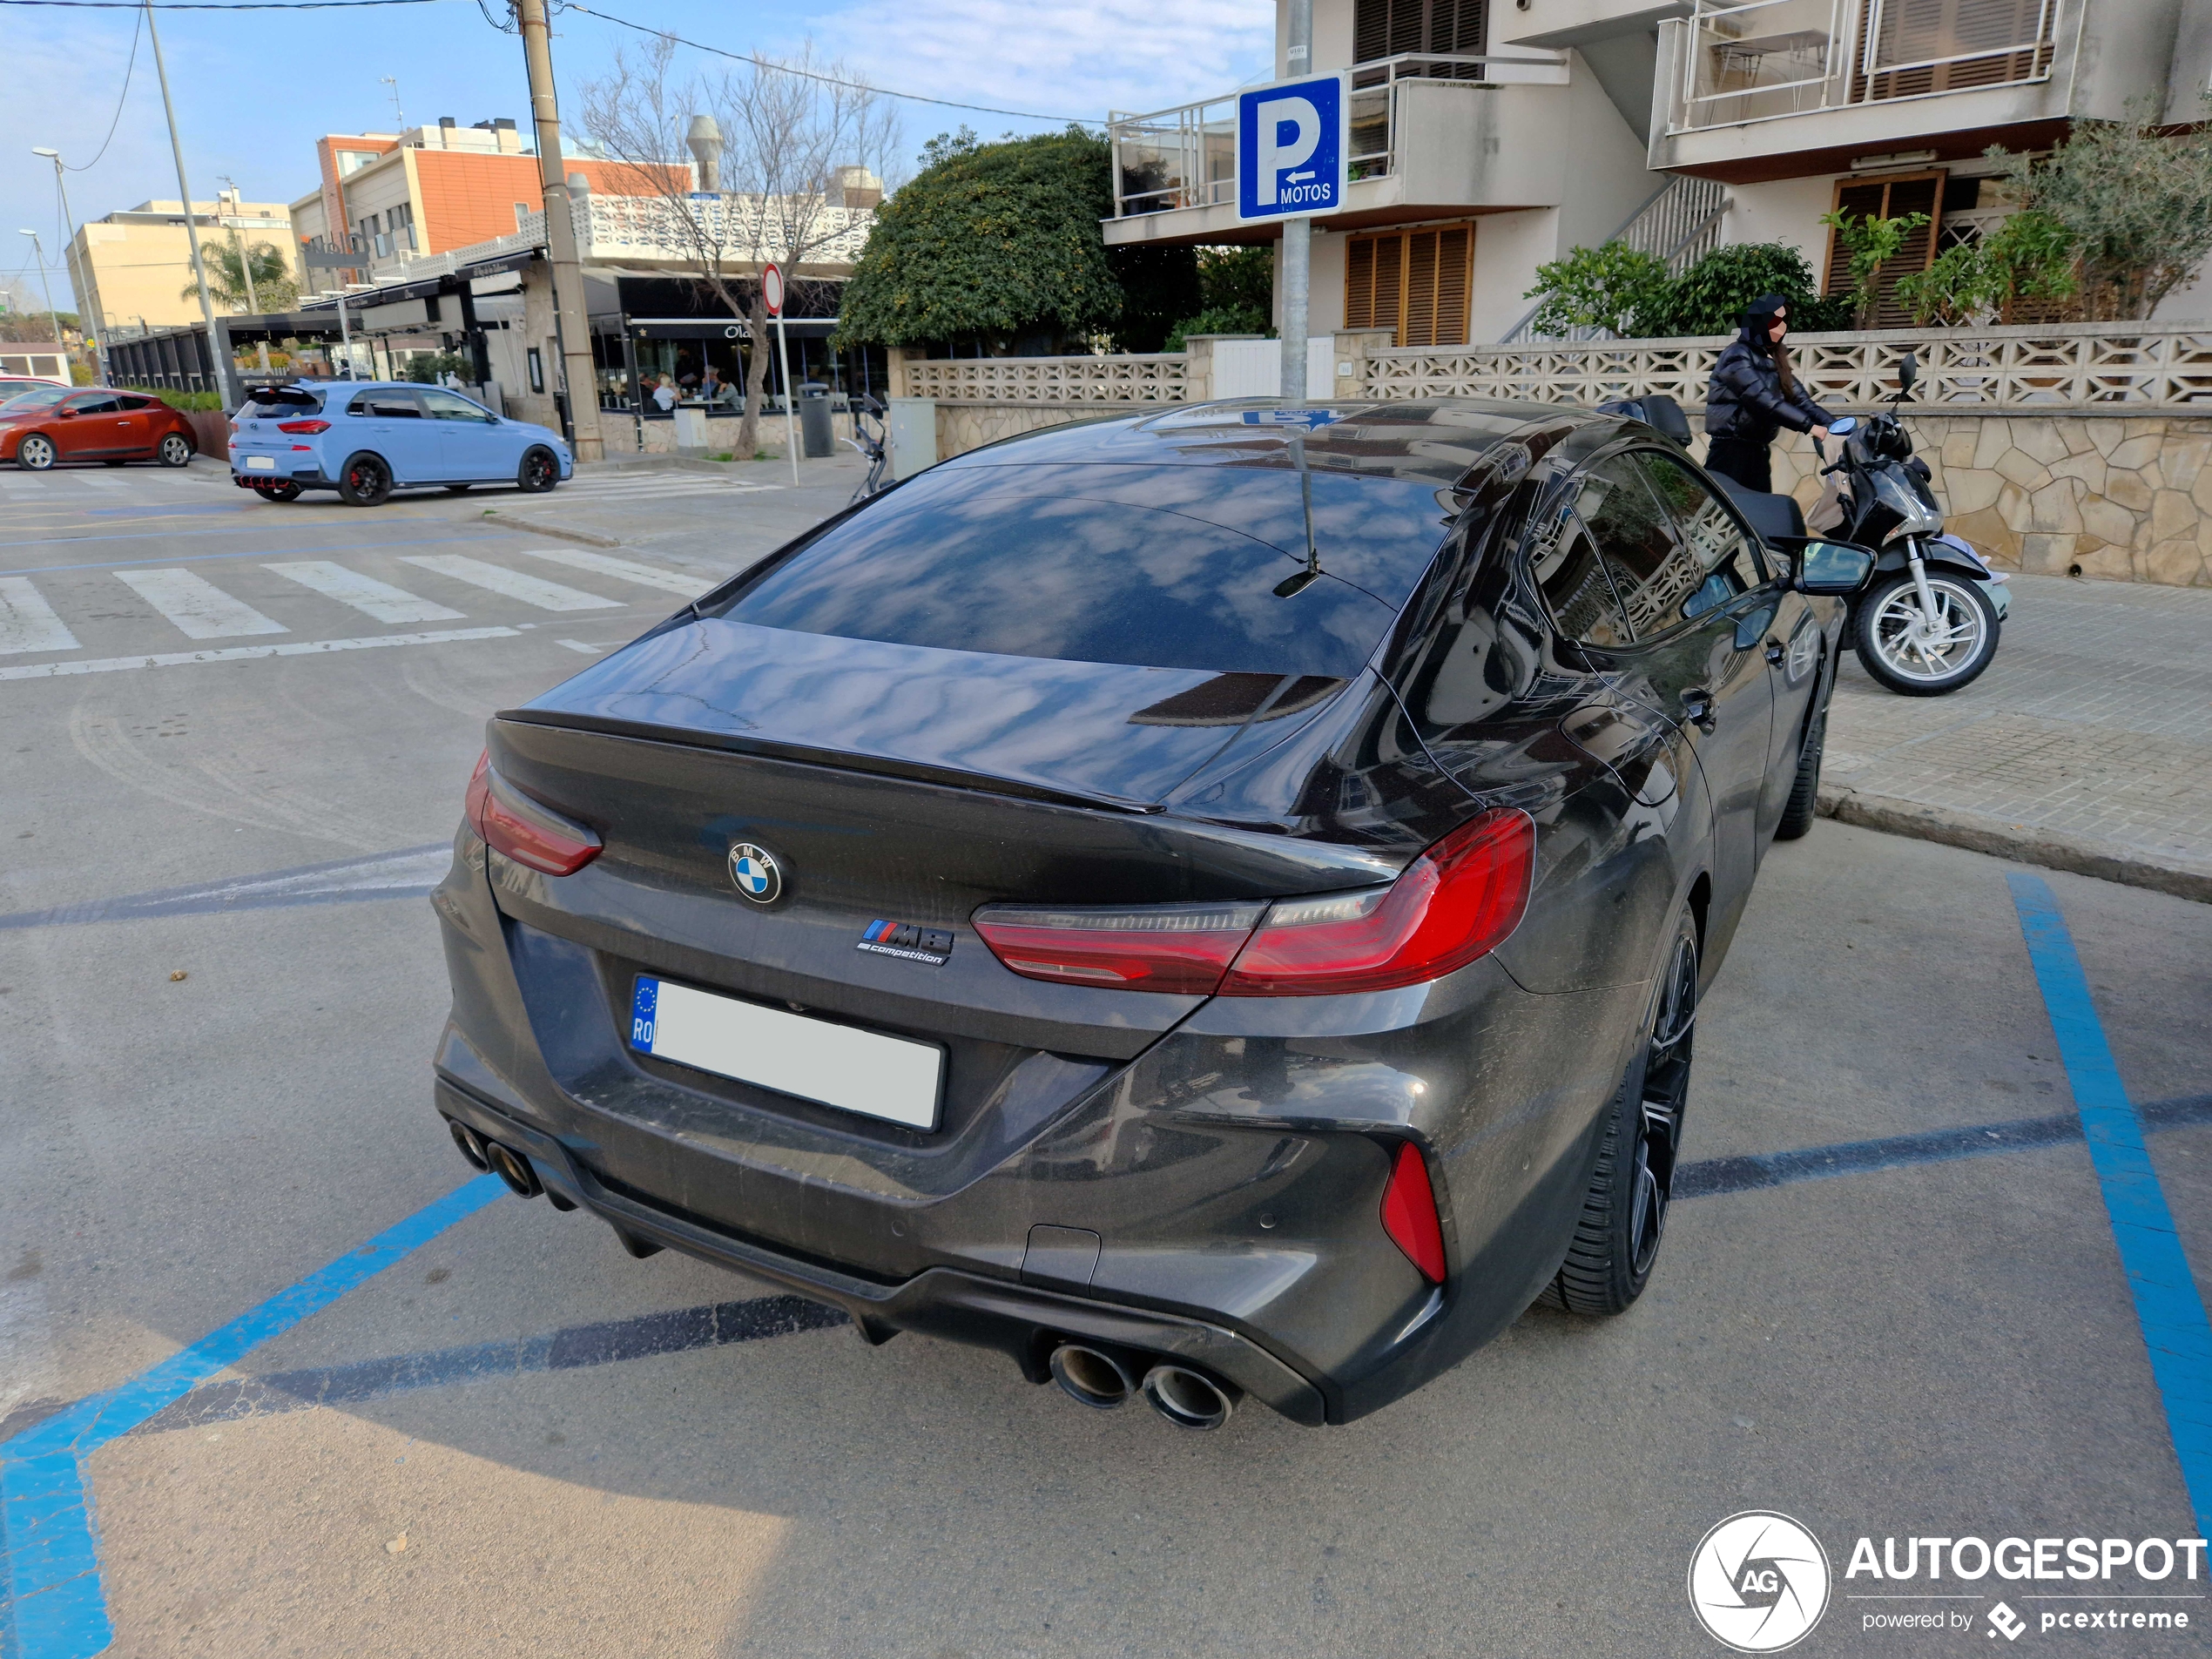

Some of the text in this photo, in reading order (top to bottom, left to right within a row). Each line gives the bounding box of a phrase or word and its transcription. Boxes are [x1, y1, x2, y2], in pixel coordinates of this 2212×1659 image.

[1258, 97, 1321, 206] P
[1280, 183, 1331, 204] MOTOS
[725, 325, 752, 339] Ola
[731, 846, 772, 869] BMW
[887, 923, 954, 955] M8
[870, 944, 942, 964] competition
[633, 1018, 652, 1042] RO
